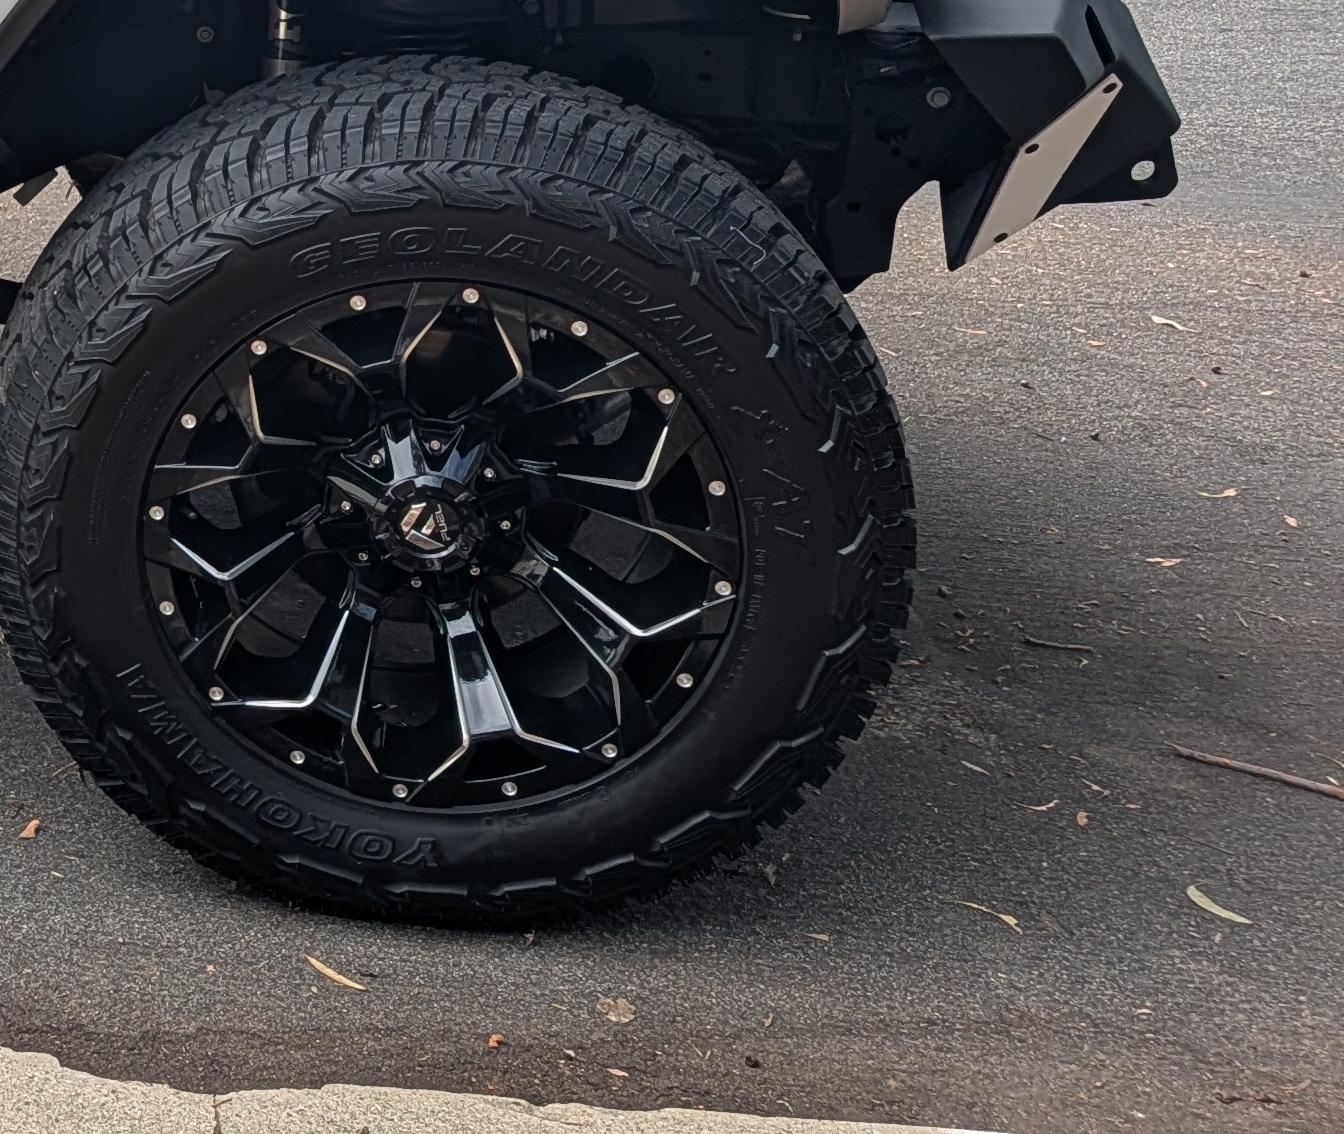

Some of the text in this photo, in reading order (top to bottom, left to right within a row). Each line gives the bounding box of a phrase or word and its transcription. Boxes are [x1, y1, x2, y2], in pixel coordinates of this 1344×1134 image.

[288, 225, 740, 376] GEOLANDAR
[433, 503, 452, 542] FUEL
[115, 662, 442, 870] YOKOHAMA
